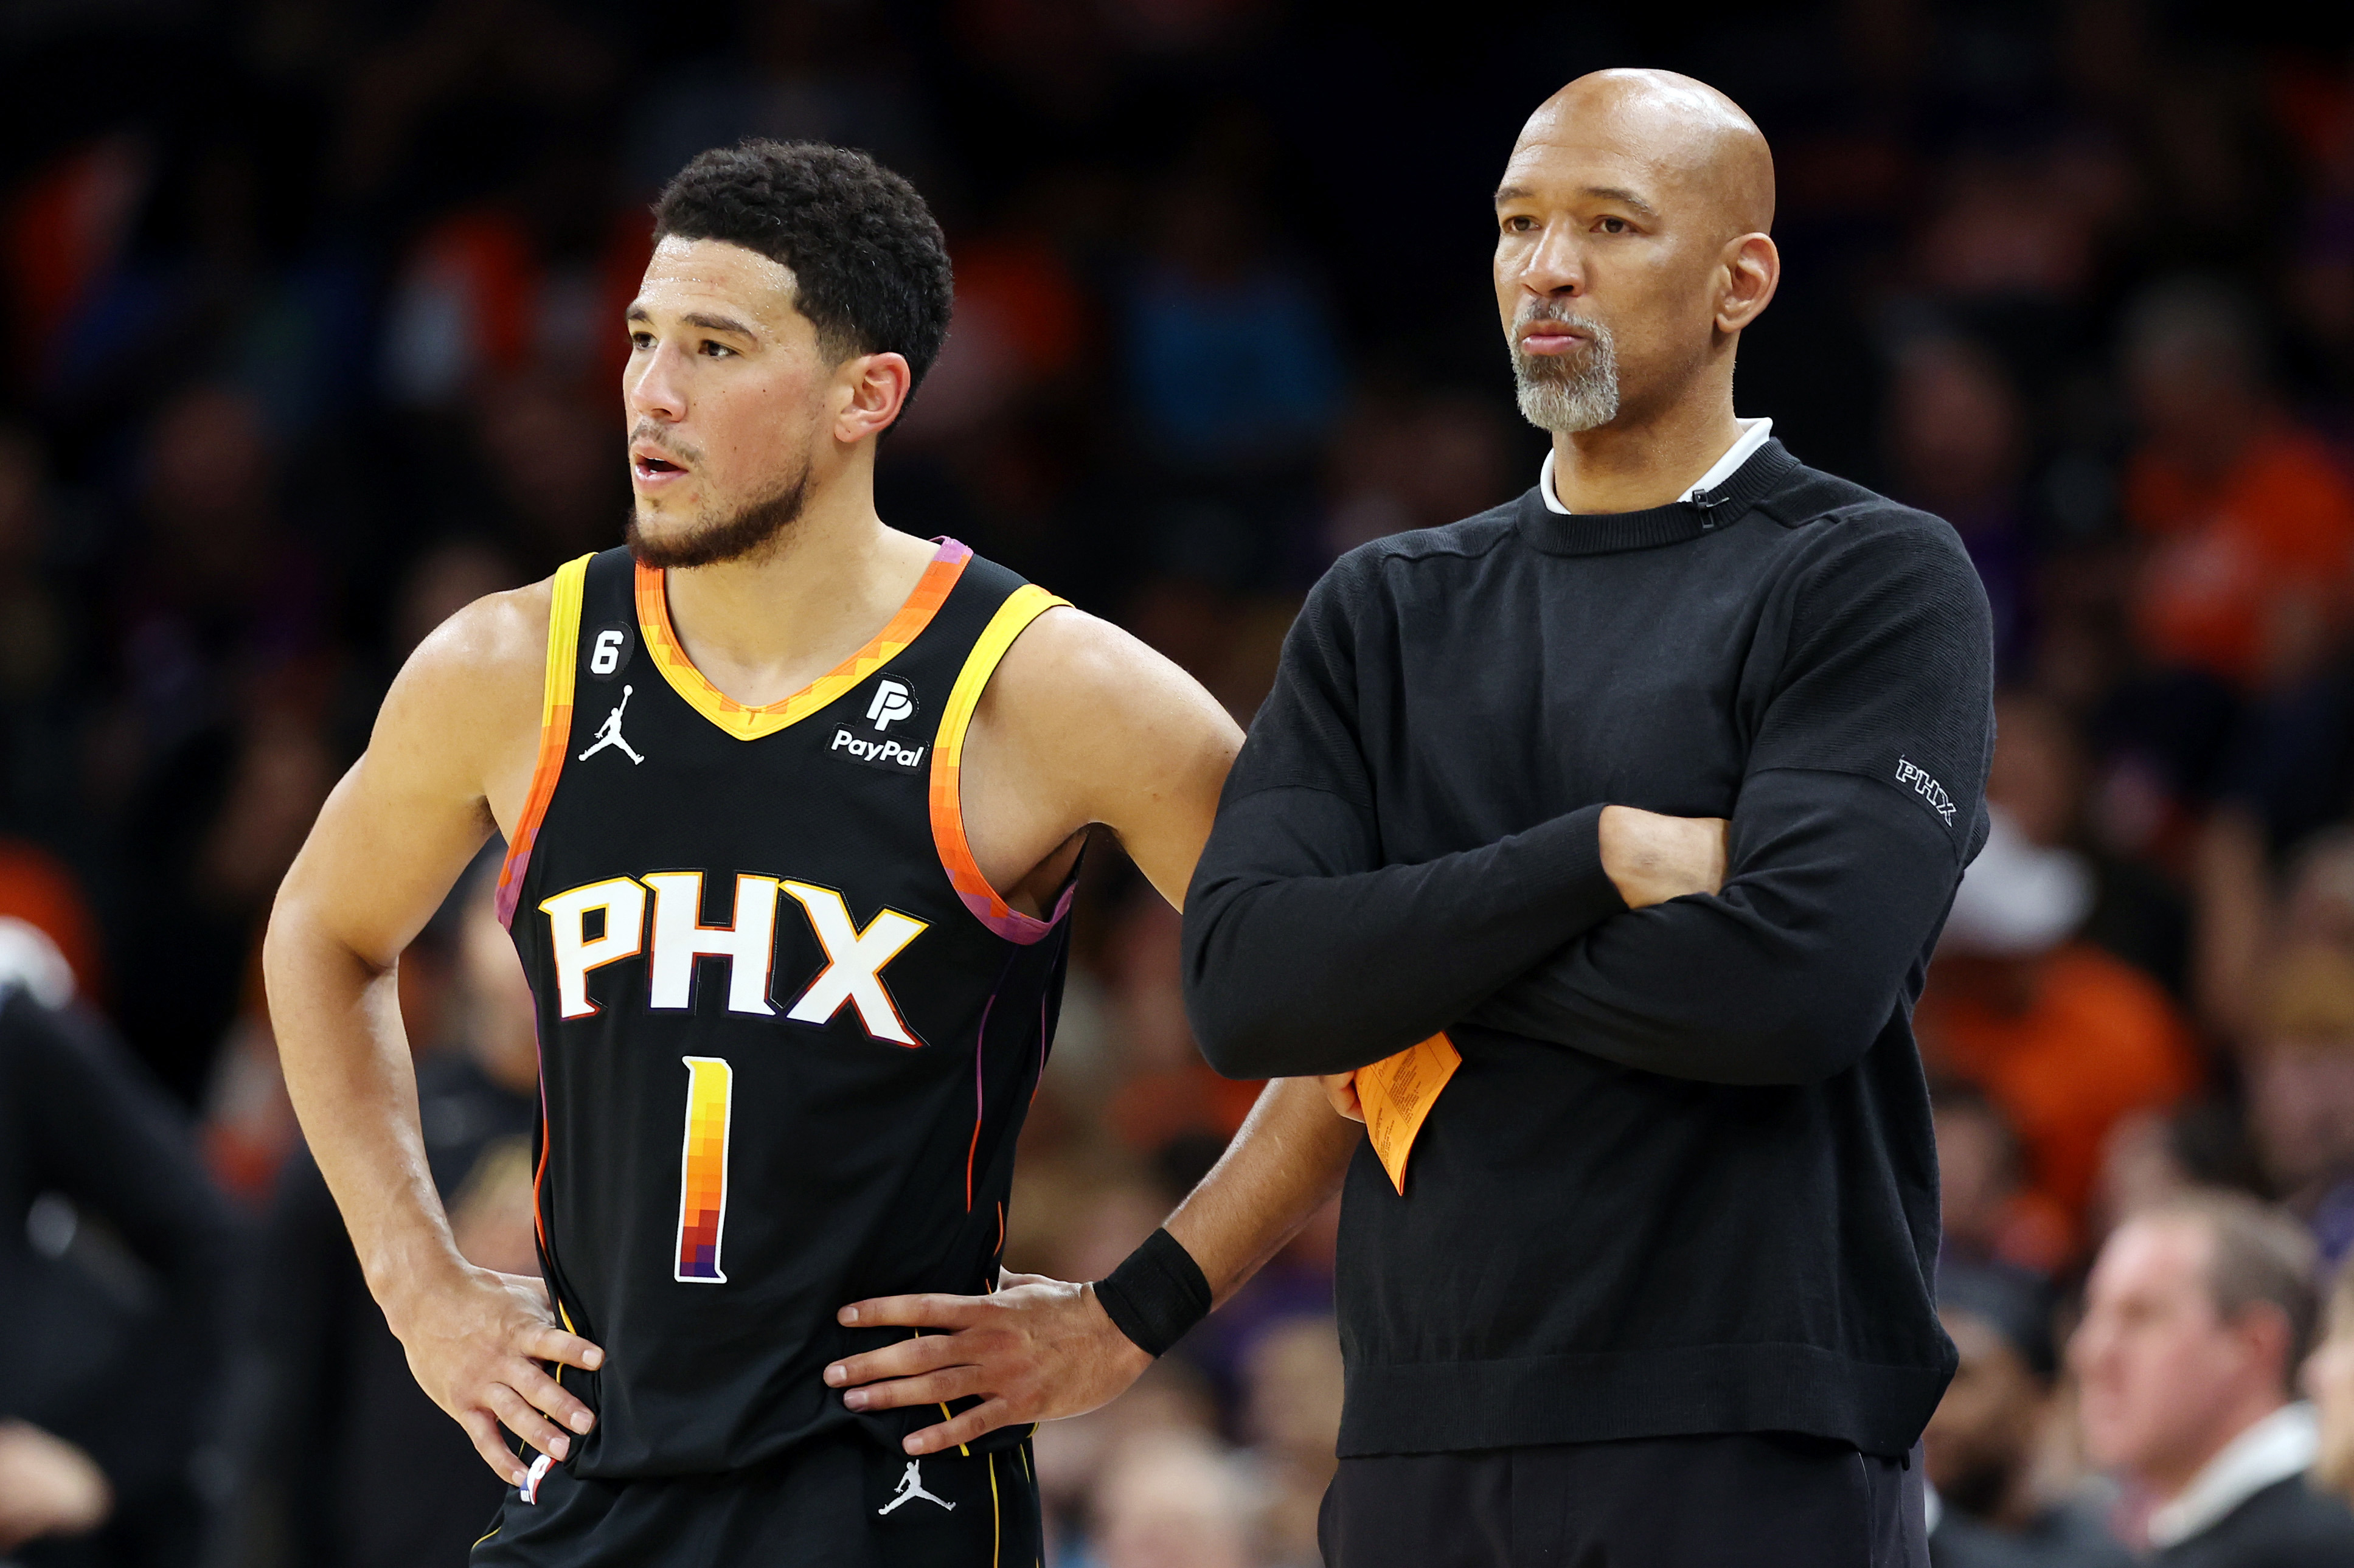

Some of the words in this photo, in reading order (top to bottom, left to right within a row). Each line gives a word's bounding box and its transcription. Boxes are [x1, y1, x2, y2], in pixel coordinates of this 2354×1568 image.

[590, 630, 624, 674] 6
[831, 729, 925, 767] PayPal
[1895, 755, 1957, 828] PHX
[538, 871, 929, 1048] PHX
[675, 1056, 732, 1283] 1
